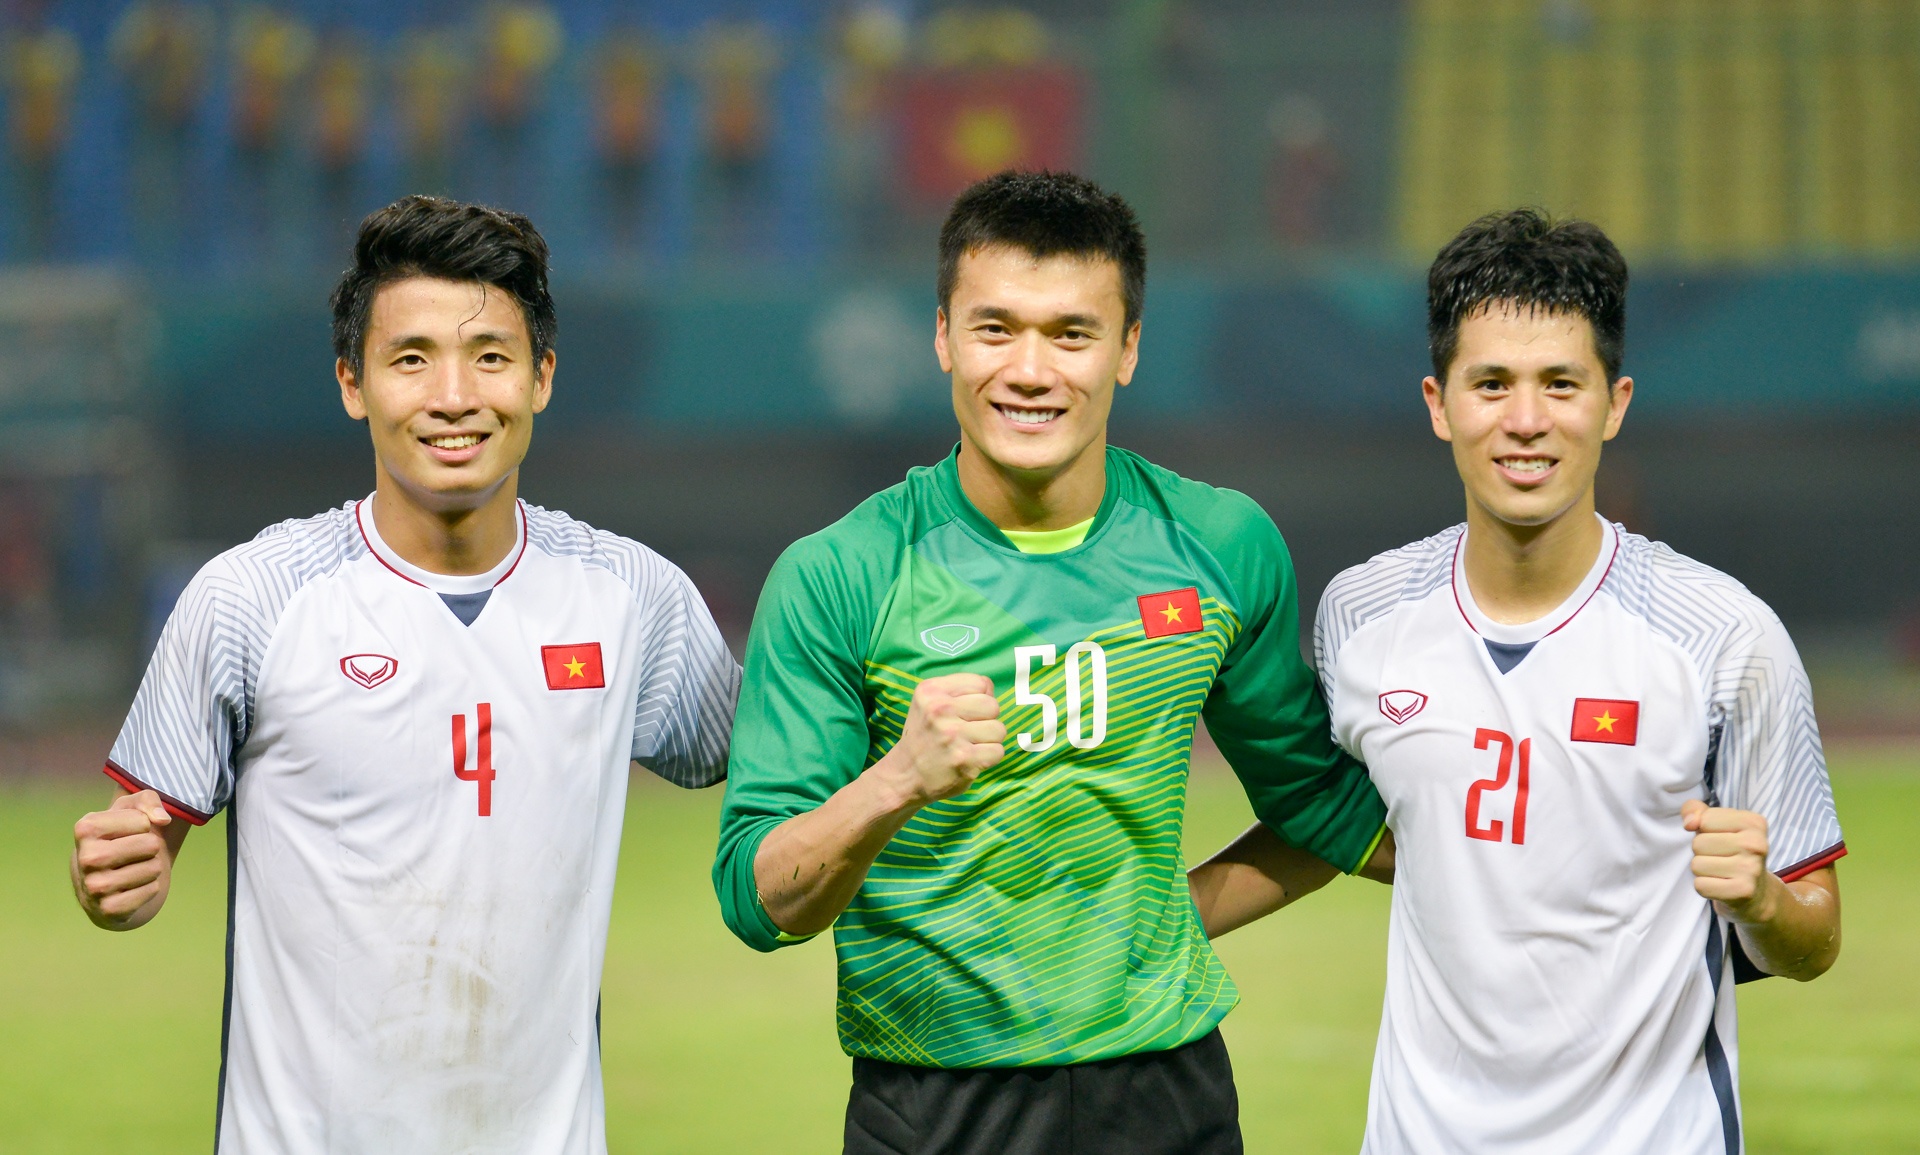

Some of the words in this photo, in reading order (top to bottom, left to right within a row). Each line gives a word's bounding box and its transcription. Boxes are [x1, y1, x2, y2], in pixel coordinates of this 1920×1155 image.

[1013, 641, 1108, 752] 50
[452, 703, 496, 816] 4
[1465, 728, 1531, 845] 21
